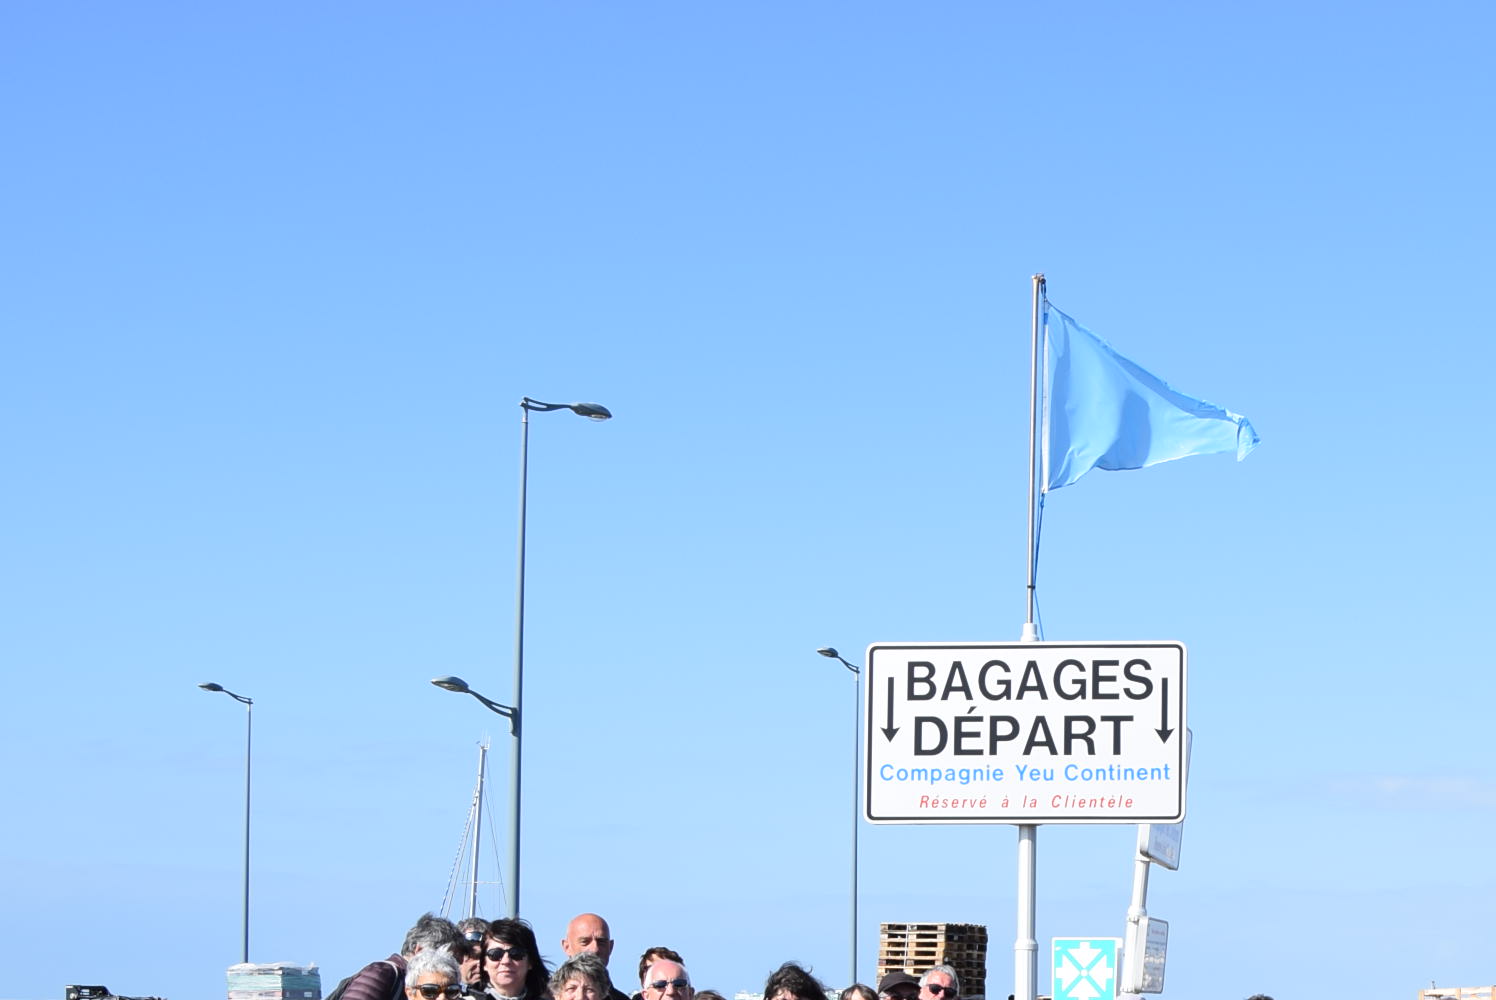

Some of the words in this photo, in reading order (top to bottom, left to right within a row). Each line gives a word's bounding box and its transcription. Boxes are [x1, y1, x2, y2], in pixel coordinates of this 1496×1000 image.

[907, 659, 1154, 701] BAGAGES
[914, 706, 1134, 756] DÉPART
[879, 763, 1005, 785] Compagnie
[1015, 764, 1055, 782] Yeu
[1064, 763, 1171, 782] Continent
[919, 794, 988, 809] Réservé
[1022, 794, 1038, 809] la
